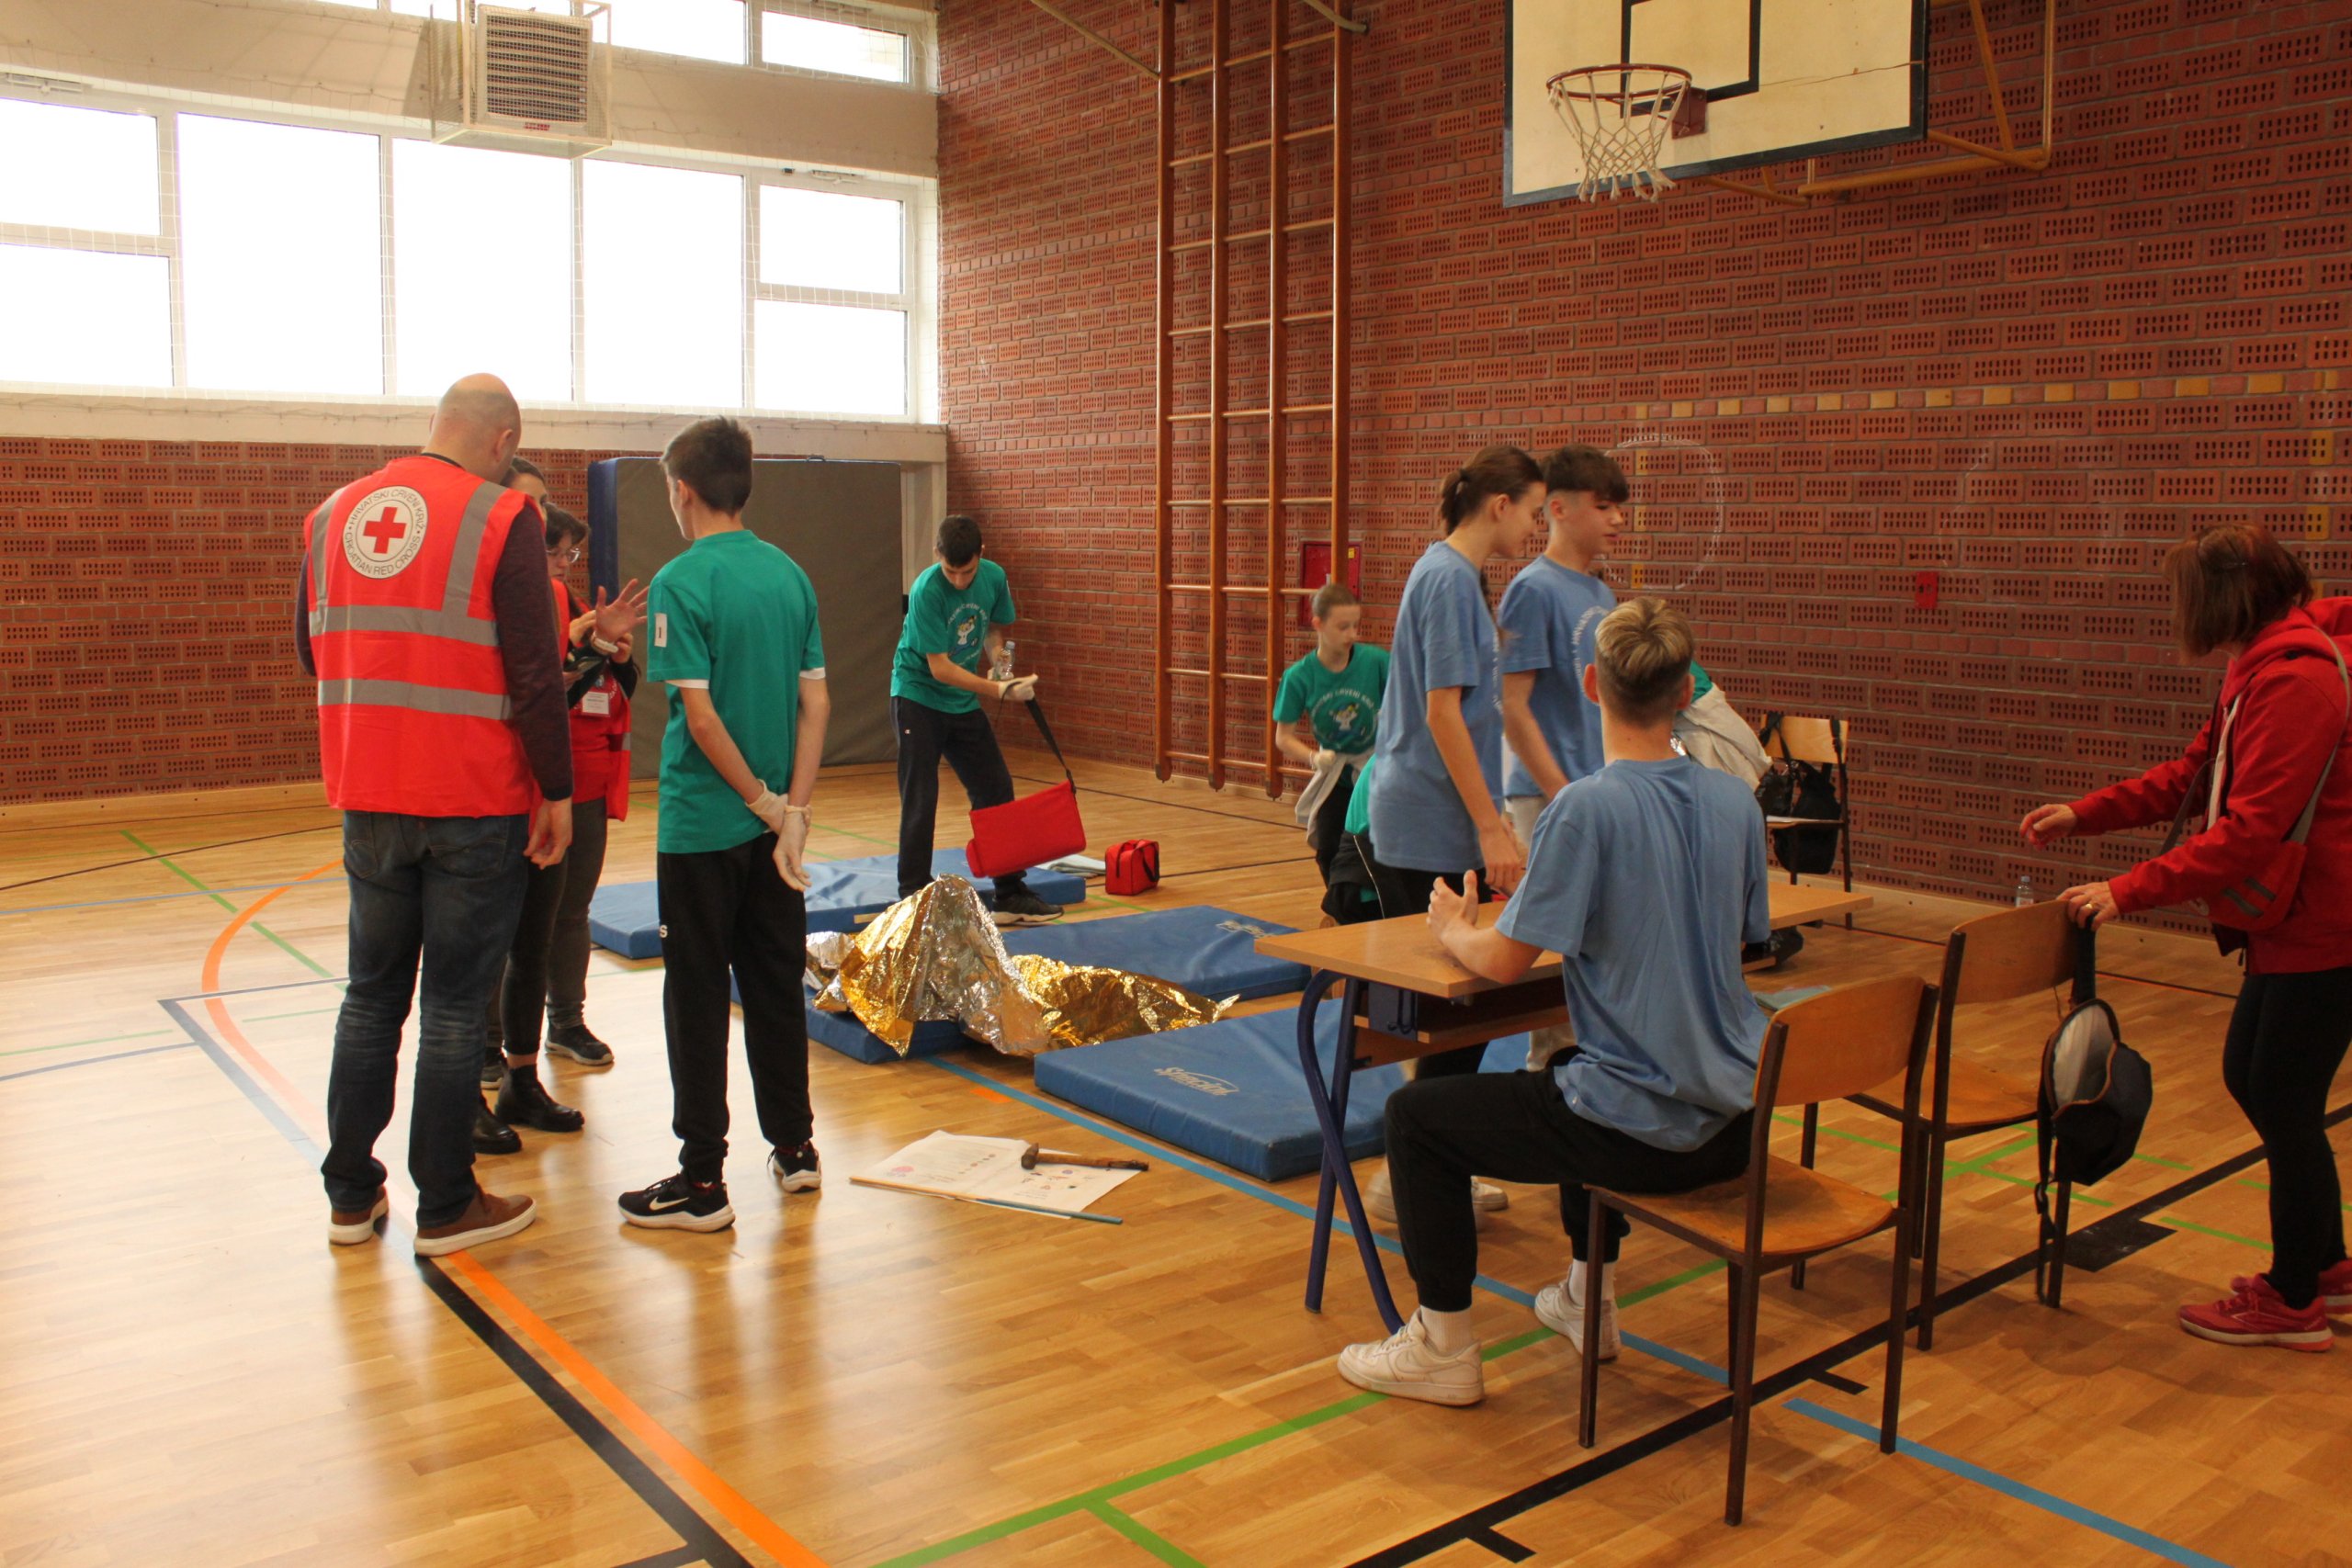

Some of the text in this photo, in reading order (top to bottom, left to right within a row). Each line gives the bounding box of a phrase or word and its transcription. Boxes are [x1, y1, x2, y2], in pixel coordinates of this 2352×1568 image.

[350, 490, 390, 525] HRVATSKI
[390, 489, 421, 508] CRVENI
[345, 532, 421, 576] CROATIAN RED CROSS
